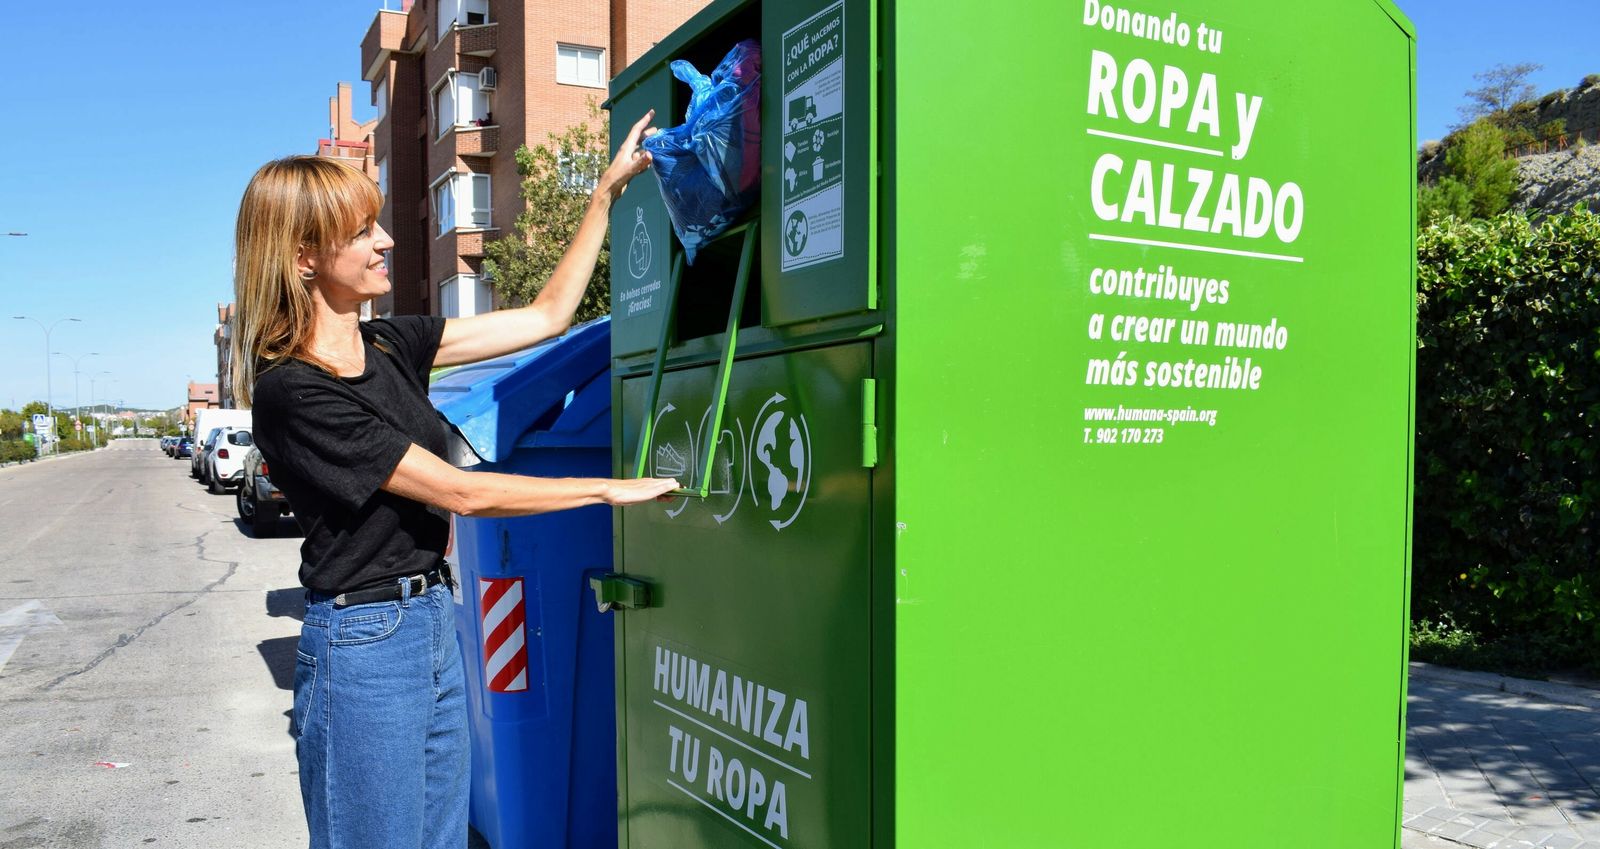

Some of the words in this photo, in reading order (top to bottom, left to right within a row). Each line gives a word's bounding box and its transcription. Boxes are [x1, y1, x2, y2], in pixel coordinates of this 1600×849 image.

[787, 33, 809, 66] ¿QUÉ
[811, 16, 840, 45] HACEMOS
[1083, 0, 1190, 47] Donando
[1197, 22, 1223, 54] tu
[788, 68, 799, 82] CON
[800, 62, 808, 74] LA
[808, 34, 839, 67] ROPA?
[1086, 49, 1220, 137] ROPA
[1231, 92, 1263, 160] y
[1091, 153, 1304, 243] CALZADO
[1089, 265, 1230, 311] contribuyes
[1088, 312, 1104, 340] a
[1110, 313, 1176, 343] crear
[1180, 319, 1209, 345] un
[1214, 318, 1288, 350] mundo
[1086, 351, 1138, 386] más
[1144, 356, 1262, 390] sostenible
[1083, 428, 1093, 443] T.
[1096, 428, 1118, 443] 902
[1121, 428, 1141, 443] 170
[1142, 428, 1164, 443] 273
[1084, 404, 1217, 426] www.humana-spain.org
[653, 646, 809, 760] HUMANIZA
[669, 725, 700, 783] TU
[706, 746, 788, 840] ROPA
